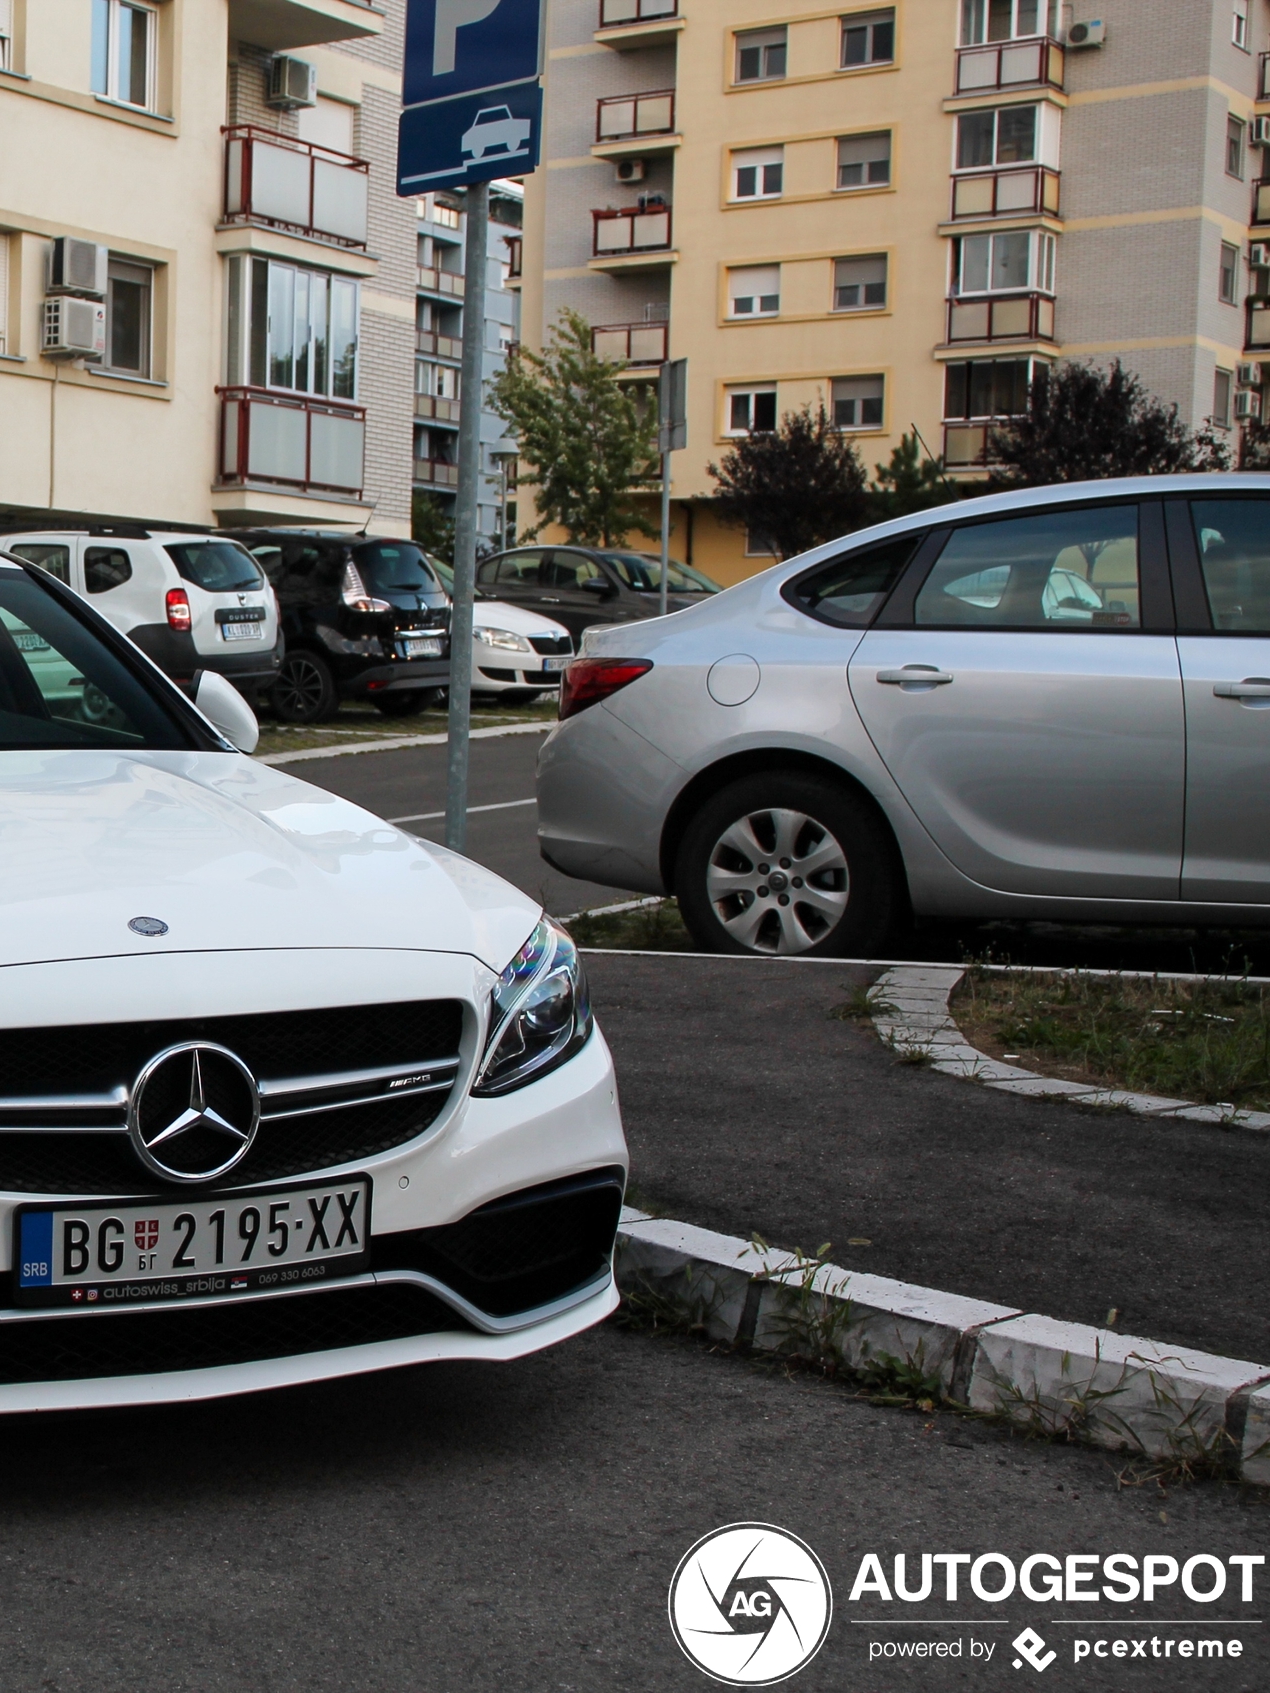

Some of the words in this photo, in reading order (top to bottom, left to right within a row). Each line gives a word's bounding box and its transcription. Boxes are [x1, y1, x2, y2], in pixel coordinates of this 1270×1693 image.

[63, 1216, 125, 1276] BG
[23, 1262, 48, 1278] SRB
[138, 1253, 158, 1271] БГ
[103, 1277, 226, 1299] autoswiss_srbija
[259, 1271, 278, 1285] 069
[280, 1269, 299, 1281] 330
[301, 1265, 326, 1278] 6063
